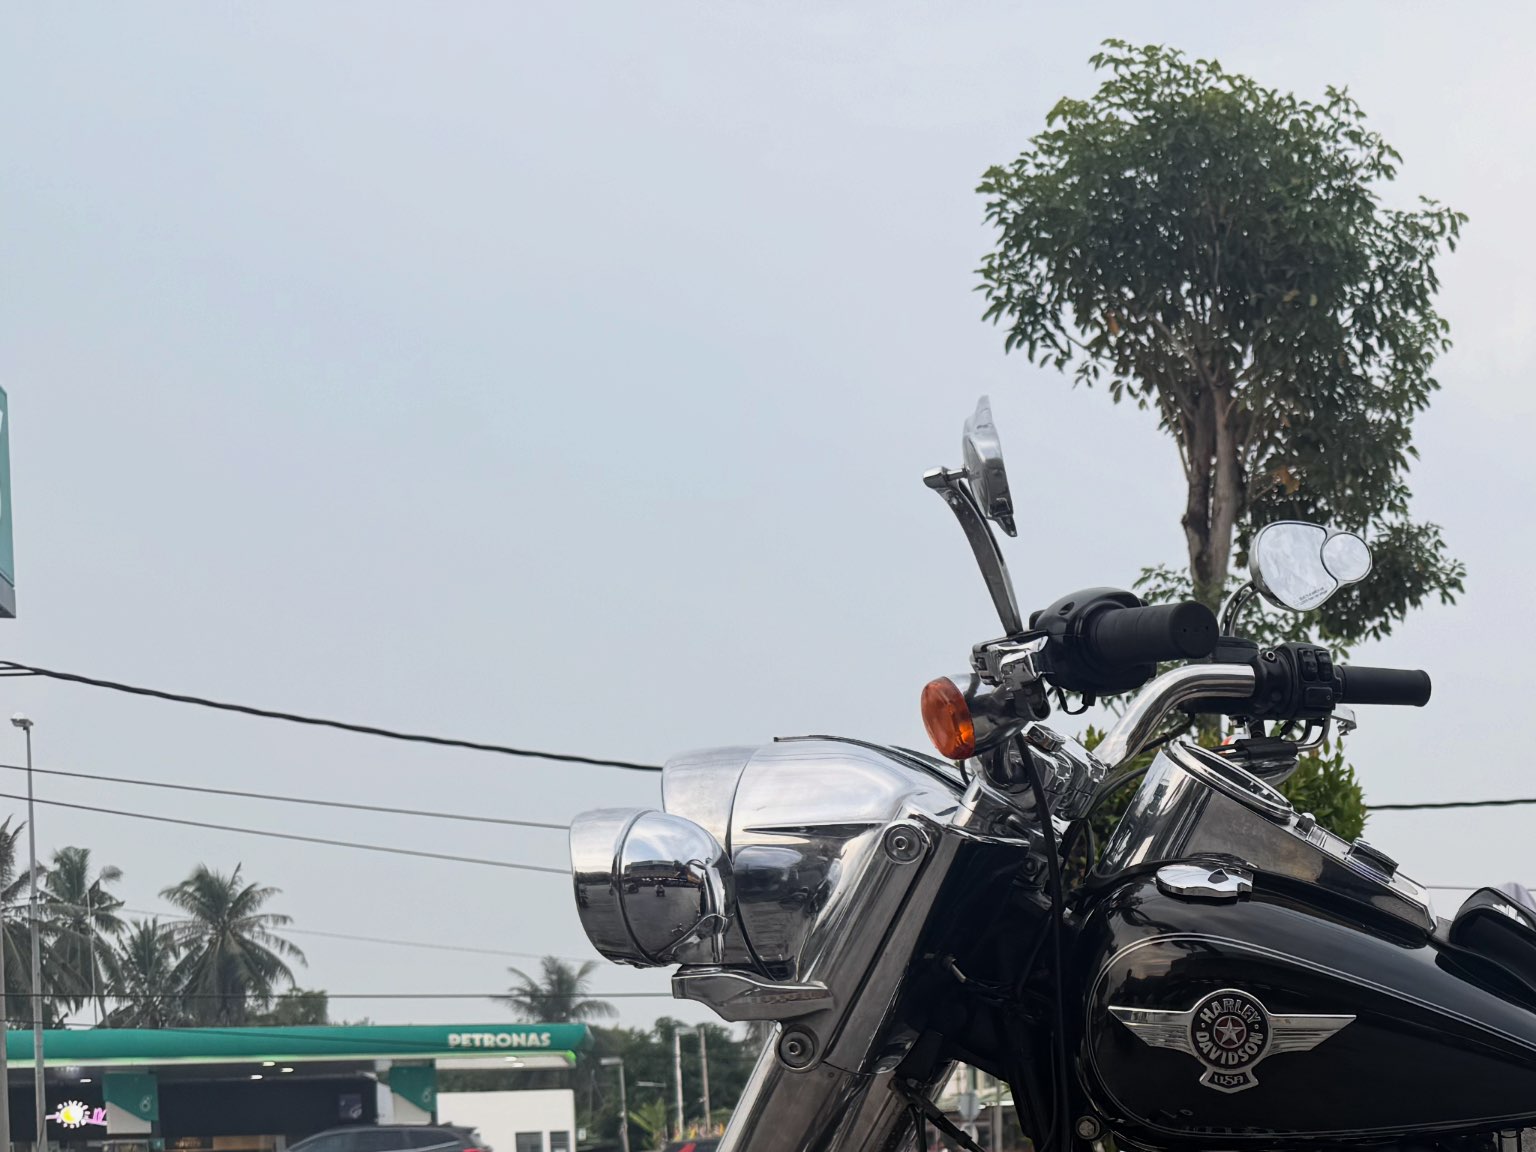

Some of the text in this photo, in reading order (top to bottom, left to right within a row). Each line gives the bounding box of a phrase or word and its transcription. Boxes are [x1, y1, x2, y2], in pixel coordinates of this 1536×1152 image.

[1200, 998, 1261, 1023] HARLEY
[448, 1032, 551, 1048] PETRONAS
[1196, 1031, 1263, 1065] DAVIDSON
